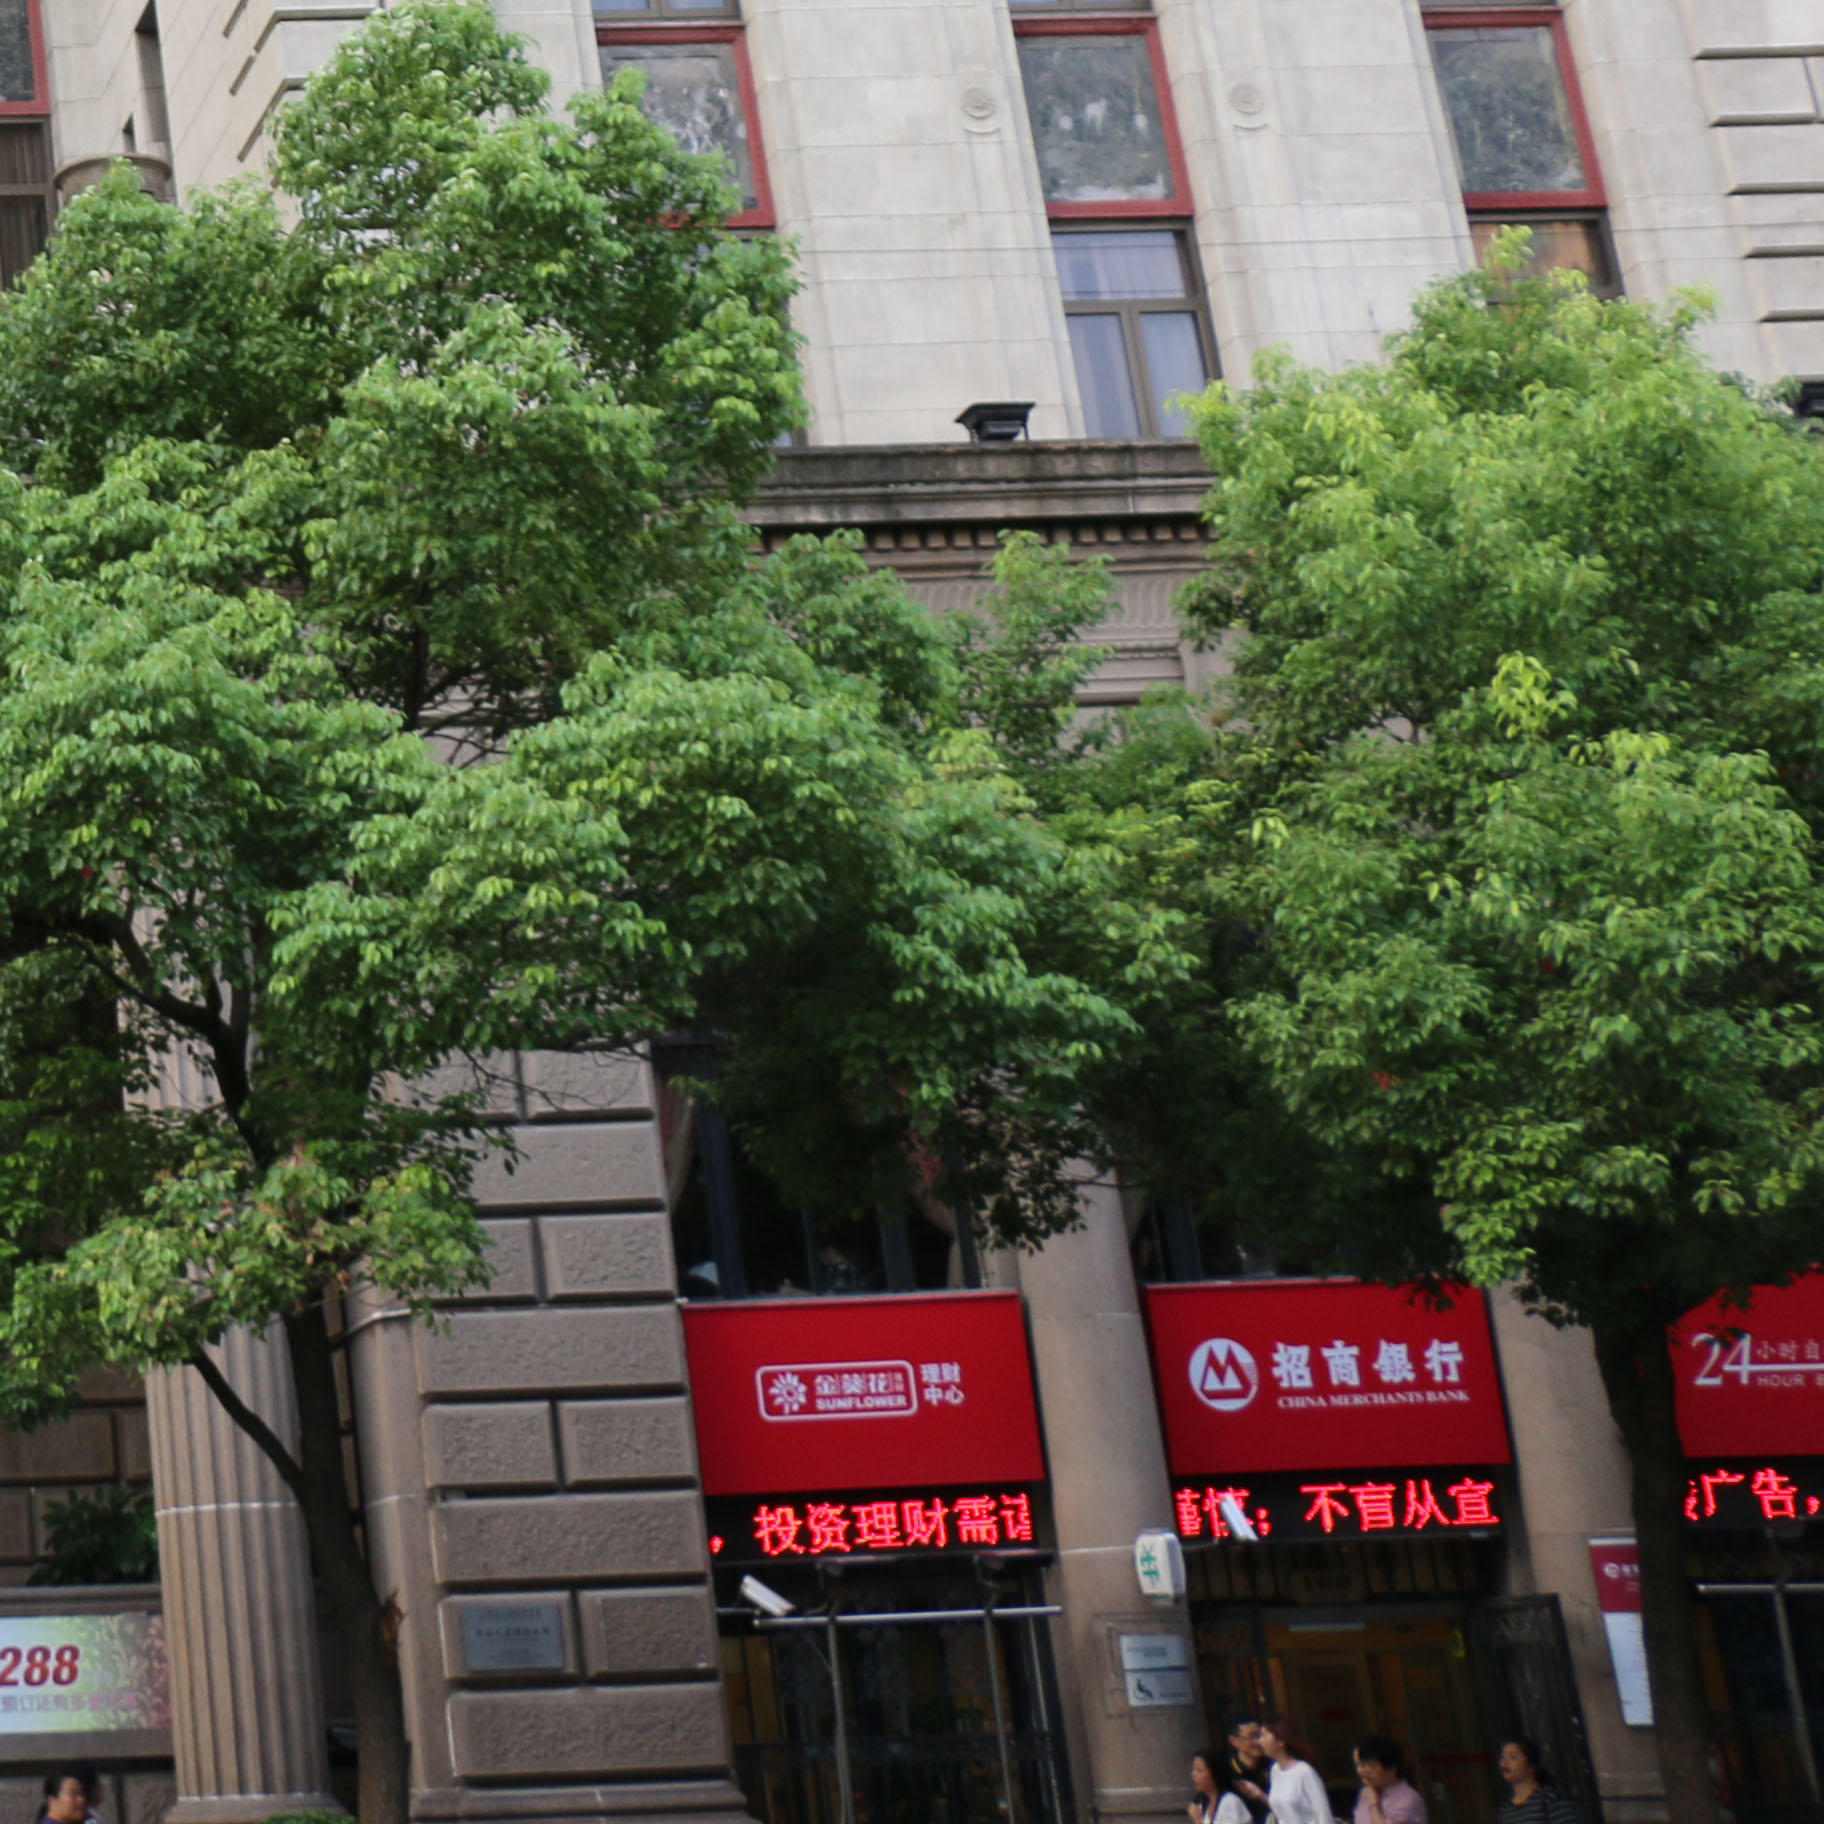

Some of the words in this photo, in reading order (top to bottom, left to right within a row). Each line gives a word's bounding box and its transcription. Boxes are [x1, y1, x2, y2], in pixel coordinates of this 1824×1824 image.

[1271, 1338, 1465, 1389] 招商银行
[1691, 1332, 1752, 1386] 24
[813, 1372, 888, 1396] 金葵花
[919, 1362, 961, 1384] 理财
[1757, 1374, 1805, 1387] HOUR
[815, 1394, 908, 1411] SUNFLOWER
[923, 1384, 966, 1406] 中心
[1277, 1395, 1328, 1409] CHINA
[1329, 1391, 1424, 1407] MERCHANTS
[1425, 1389, 1471, 1404] BANK
